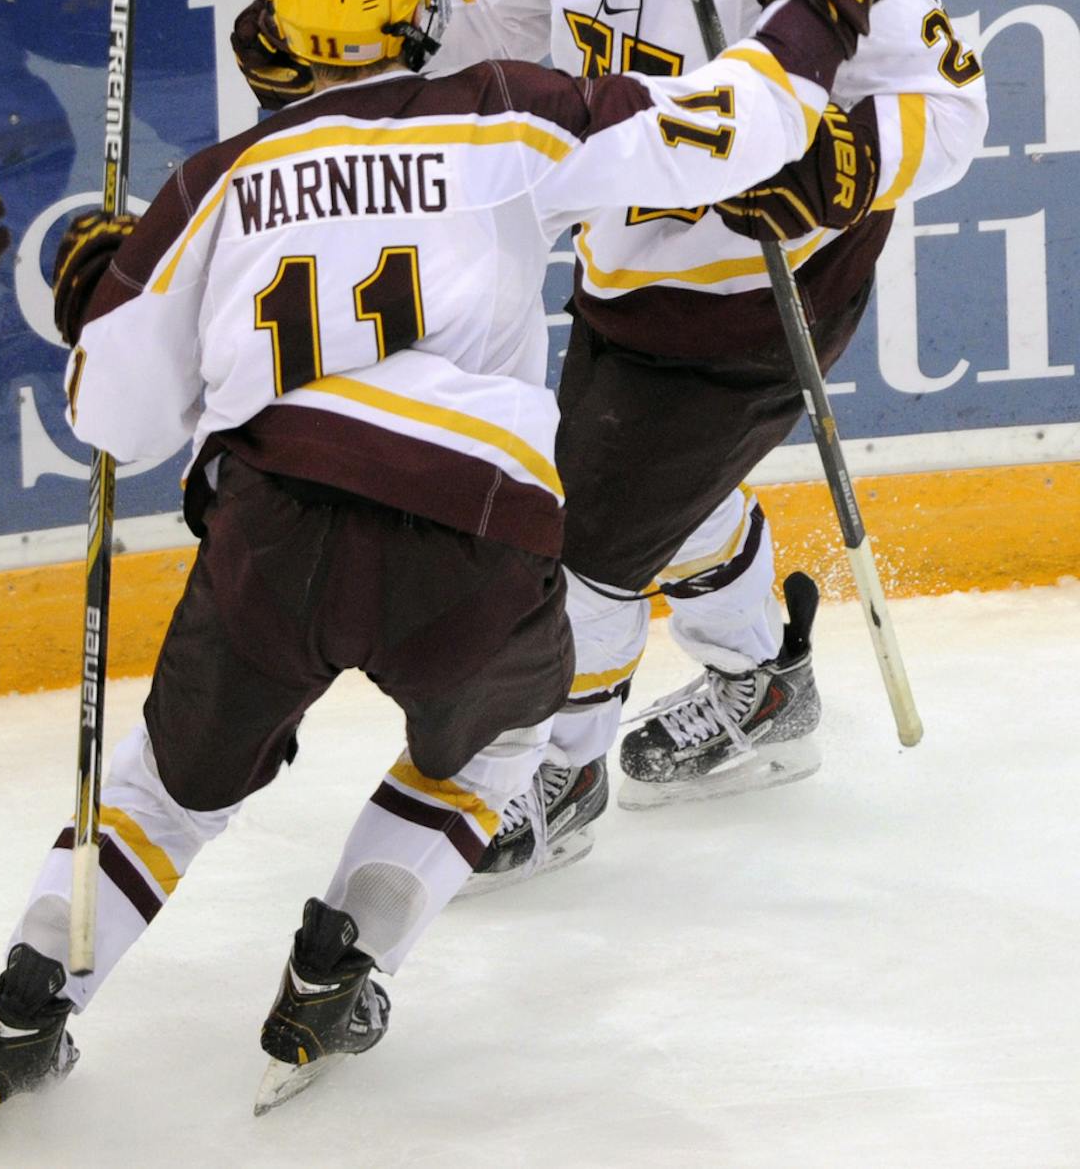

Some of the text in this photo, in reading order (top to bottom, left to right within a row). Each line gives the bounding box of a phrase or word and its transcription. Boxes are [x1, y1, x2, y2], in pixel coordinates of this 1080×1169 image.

[310, 34, 342, 59] 11
[657, 84, 737, 161] 11
[232, 152, 447, 236] WARNING
[254, 244, 427, 398] 11
[82, 605, 103, 728] BAUER
